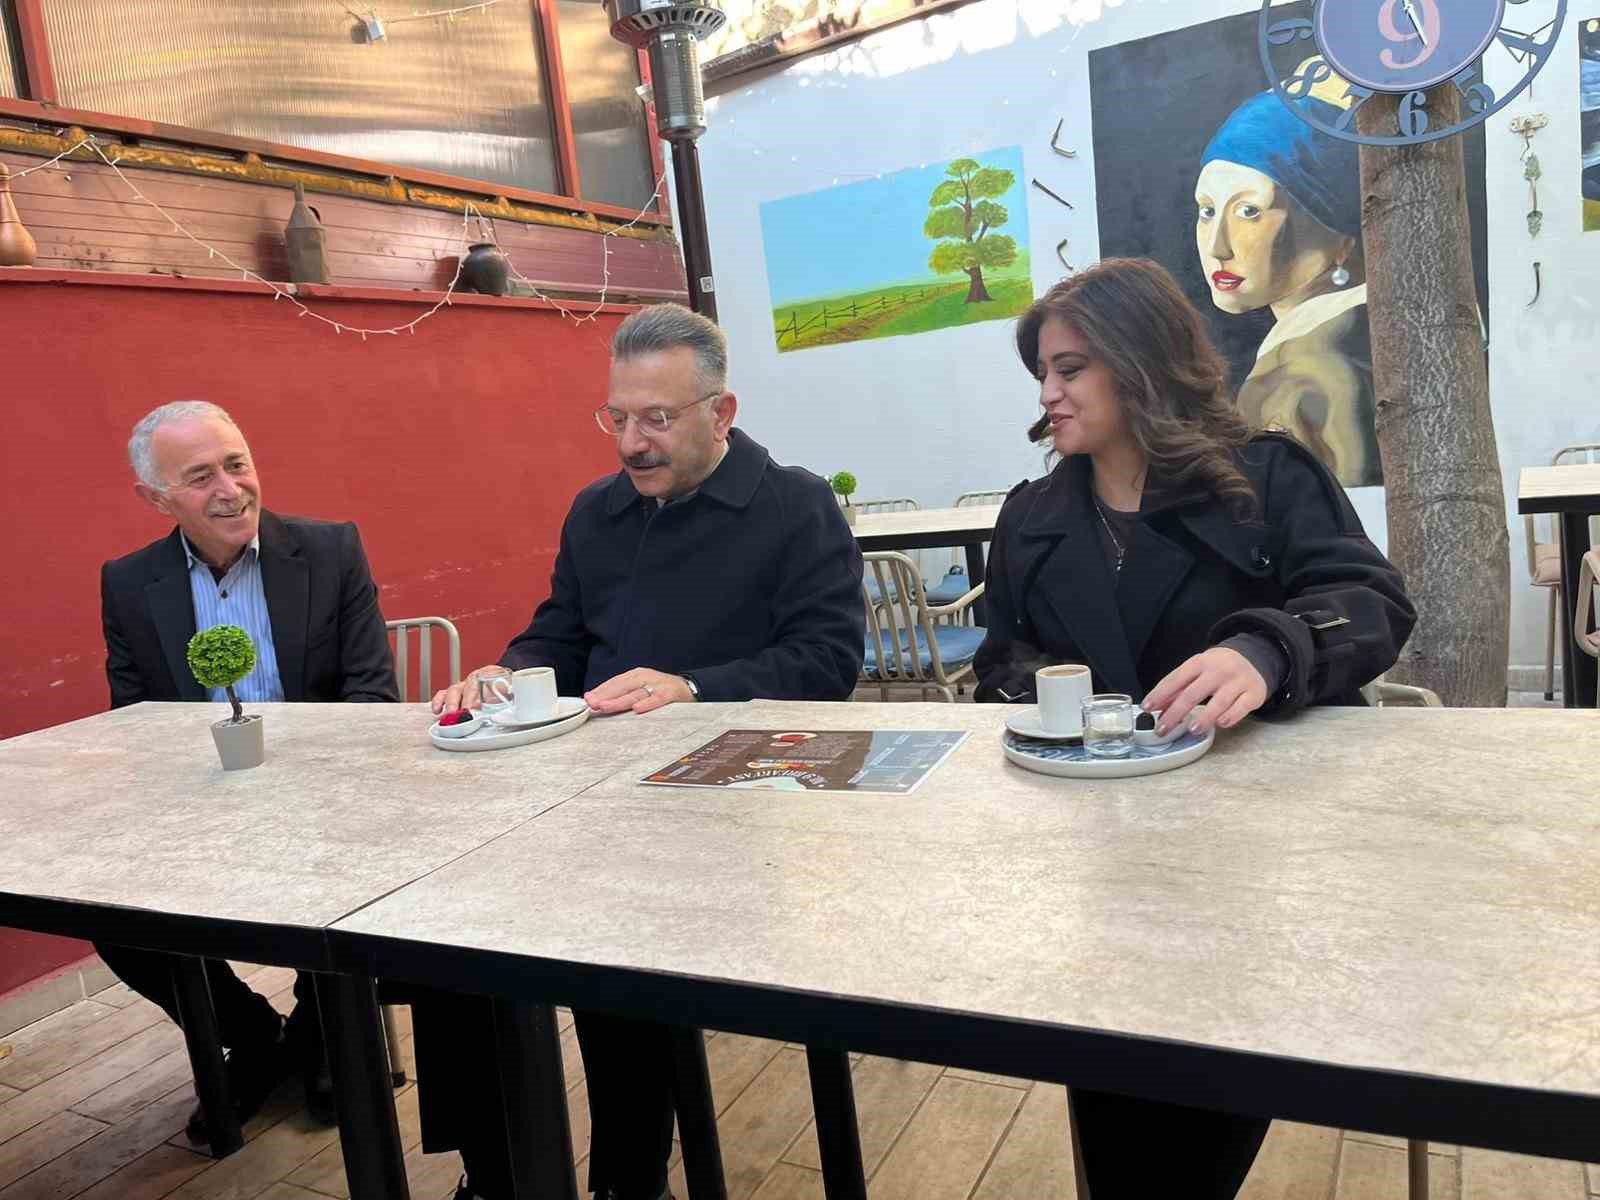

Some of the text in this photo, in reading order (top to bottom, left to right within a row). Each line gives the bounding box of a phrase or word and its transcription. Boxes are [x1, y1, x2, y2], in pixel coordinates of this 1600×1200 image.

[1284, 60, 1332, 100] 8
[1455, 66, 1496, 114] 5
[1336, 82, 1376, 132] 7
[1399, 91, 1428, 136] 6
